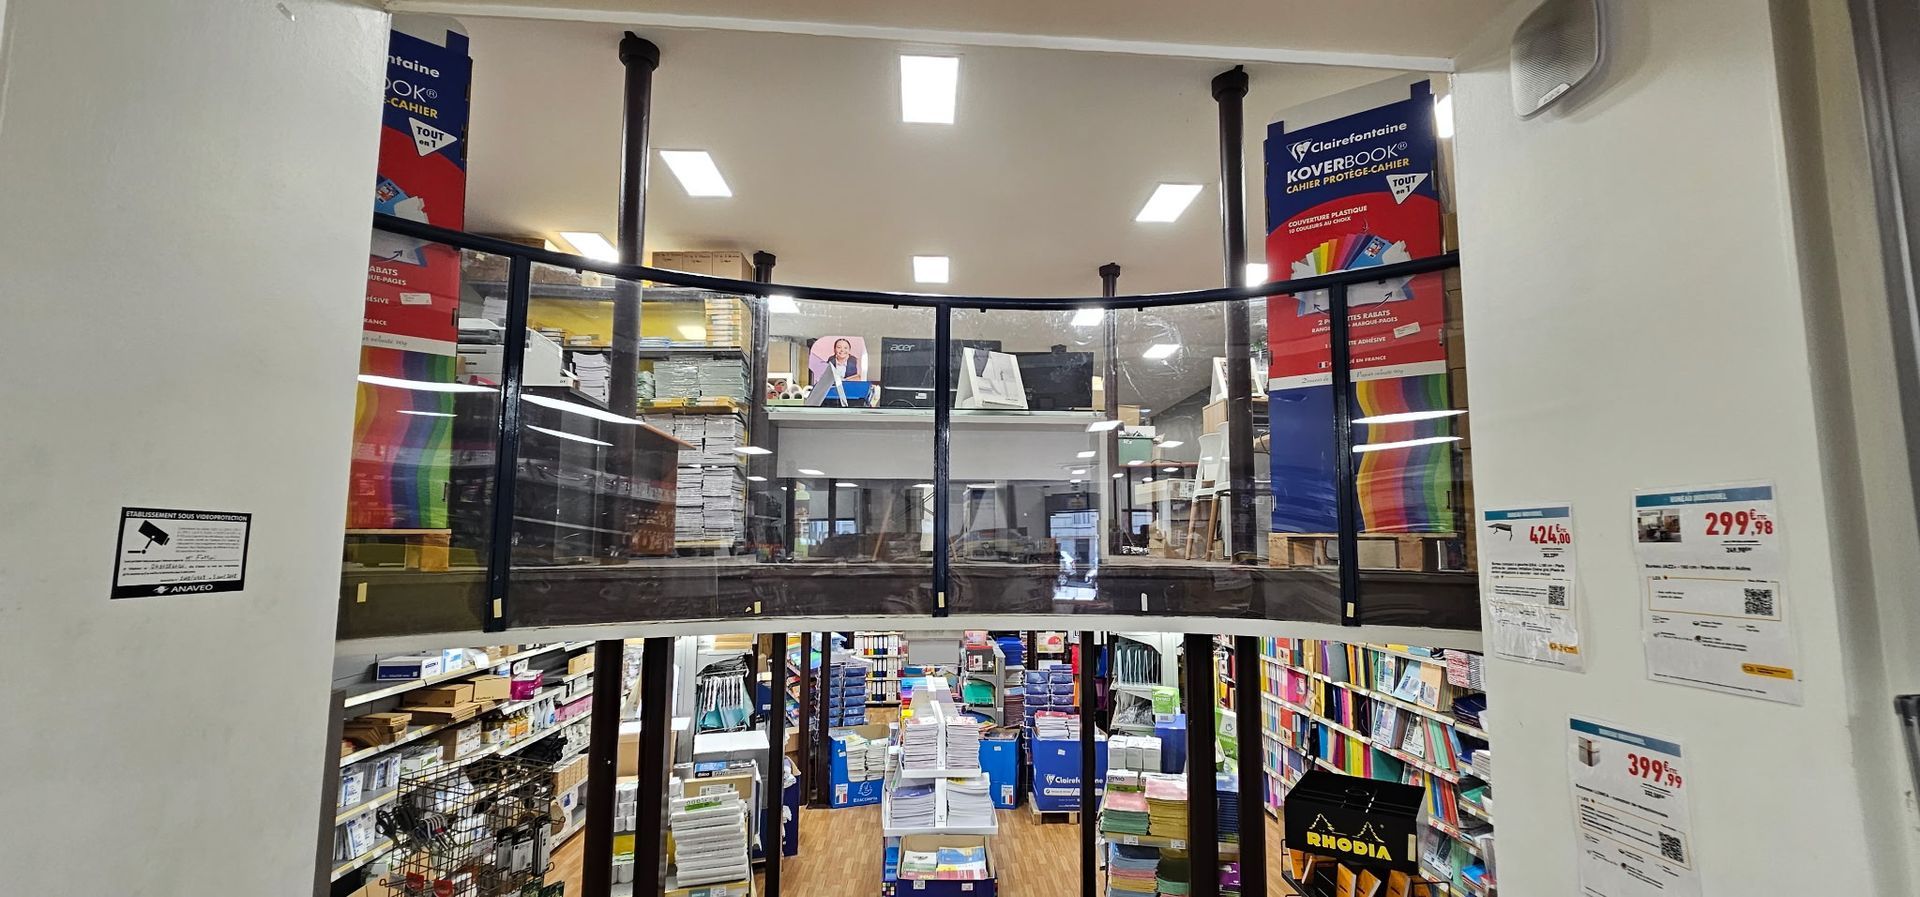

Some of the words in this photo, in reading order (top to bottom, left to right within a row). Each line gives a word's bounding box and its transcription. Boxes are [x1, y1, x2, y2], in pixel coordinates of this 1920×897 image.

[416, 126, 444, 141] TOUT
[1310, 122, 1408, 153] Clairefontaine
[419, 139, 430, 147] en
[431, 140, 436, 148] 1
[1286, 179, 1320, 194] CAHIER
[1323, 158, 1411, 185] PROTÈGE-CAHIER
[1392, 175, 1417, 187] TOUT
[1288, 213, 1330, 228] COUVERTURE
[1331, 205, 1367, 218] PLASTIQUE
[1296, 223, 1323, 233] COULEURS
[1333, 216, 1352, 224] CHOIX
[1363, 309, 1391, 319] RABATS
[1352, 316, 1398, 327] MARQUE-PAGES
[1357, 336, 1386, 345] ADHÉSIVE
[125, 510, 177, 519] ETABLISSEMENT
[178, 512, 195, 520] SOUS
[196, 513, 248, 521] VIDEOPROTECTION
[170, 584, 213, 593] ANAVEO
[1306, 831, 1392, 861] RHODIA
